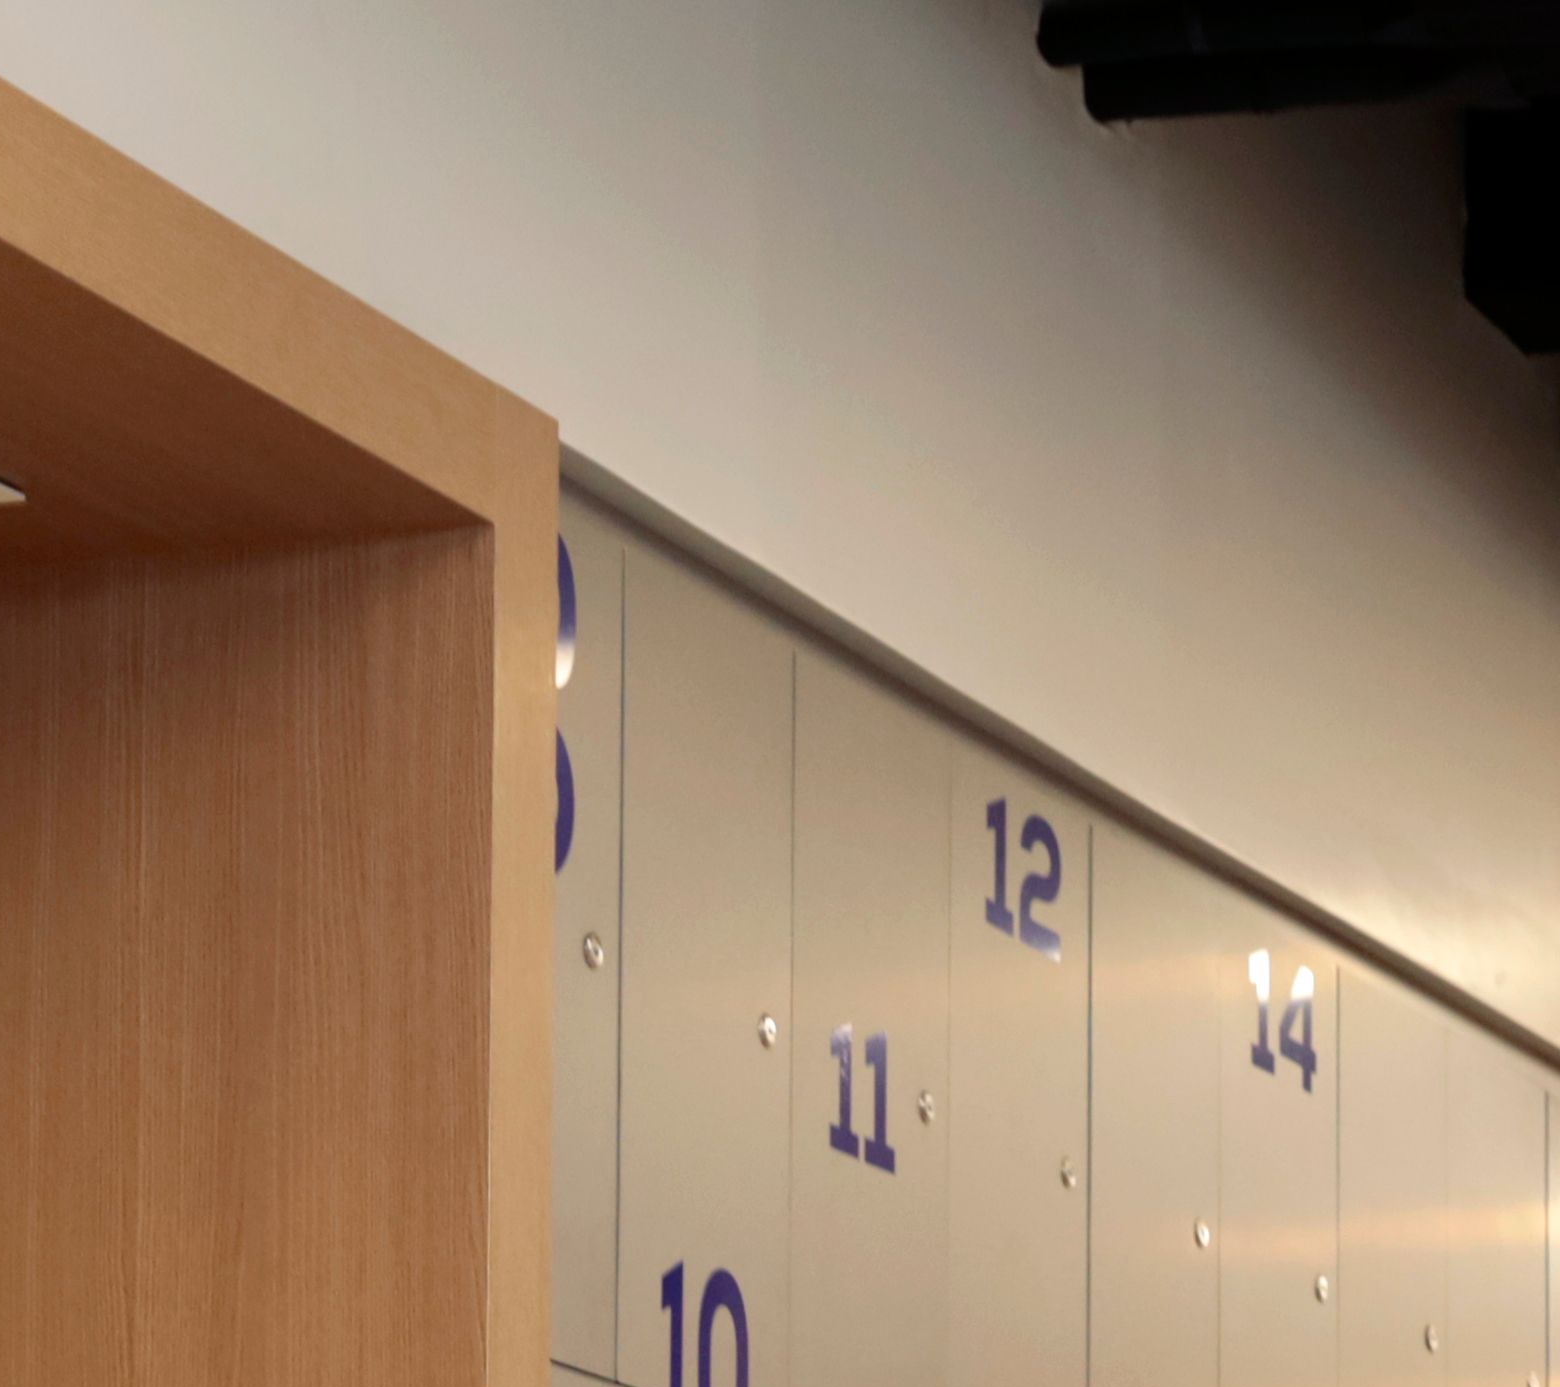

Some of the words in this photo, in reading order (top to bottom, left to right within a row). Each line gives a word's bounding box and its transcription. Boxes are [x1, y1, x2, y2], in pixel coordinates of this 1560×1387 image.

[985, 797, 1061, 962] 12
[1248, 948, 1317, 1093] 14
[829, 1021, 897, 1174] 11
